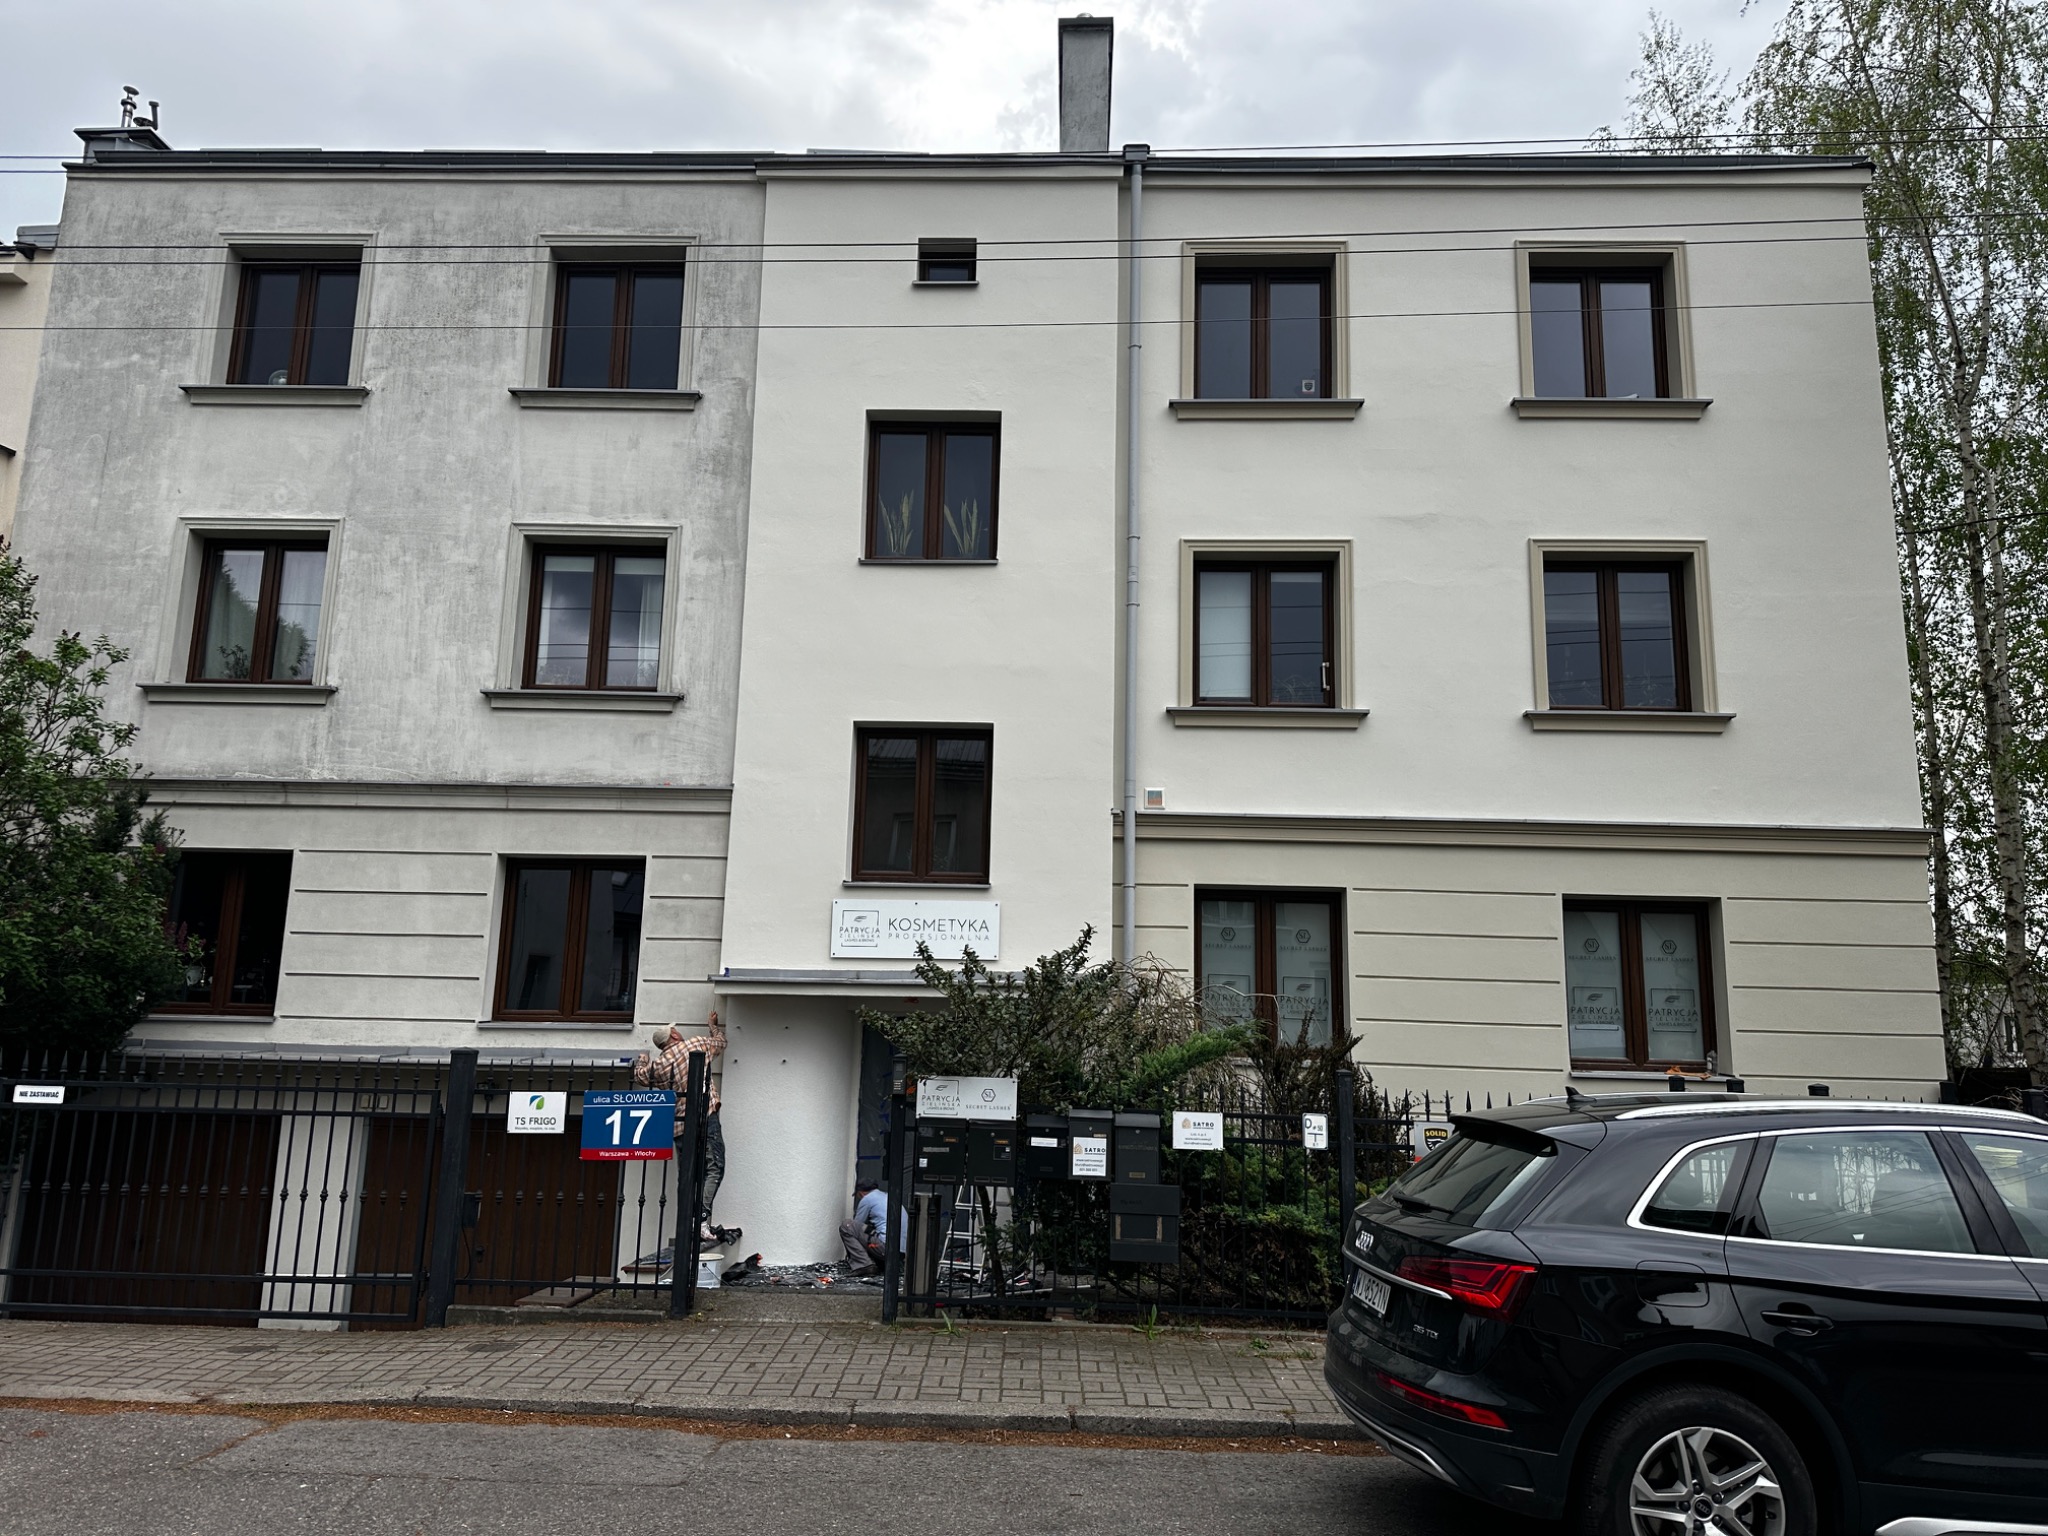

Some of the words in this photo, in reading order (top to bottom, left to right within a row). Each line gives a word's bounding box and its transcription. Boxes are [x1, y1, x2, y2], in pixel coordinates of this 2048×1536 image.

[888, 918, 989, 932] KOSMETYKA
[839, 926, 880, 934] PATRYCJA
[888, 933, 989, 941] PROFESJONALNA
[1571, 1006, 1620, 1015] PATRYCJA
[1649, 1008, 1698, 1017] PATRYCJA
[613, 1094, 666, 1103] SŁOWICZA
[921, 1095, 961, 1103] PATRYCJA
[515, 1117, 526, 1125] TS
[529, 1117, 556, 1125] FRIGO
[605, 1109, 653, 1145] 17
